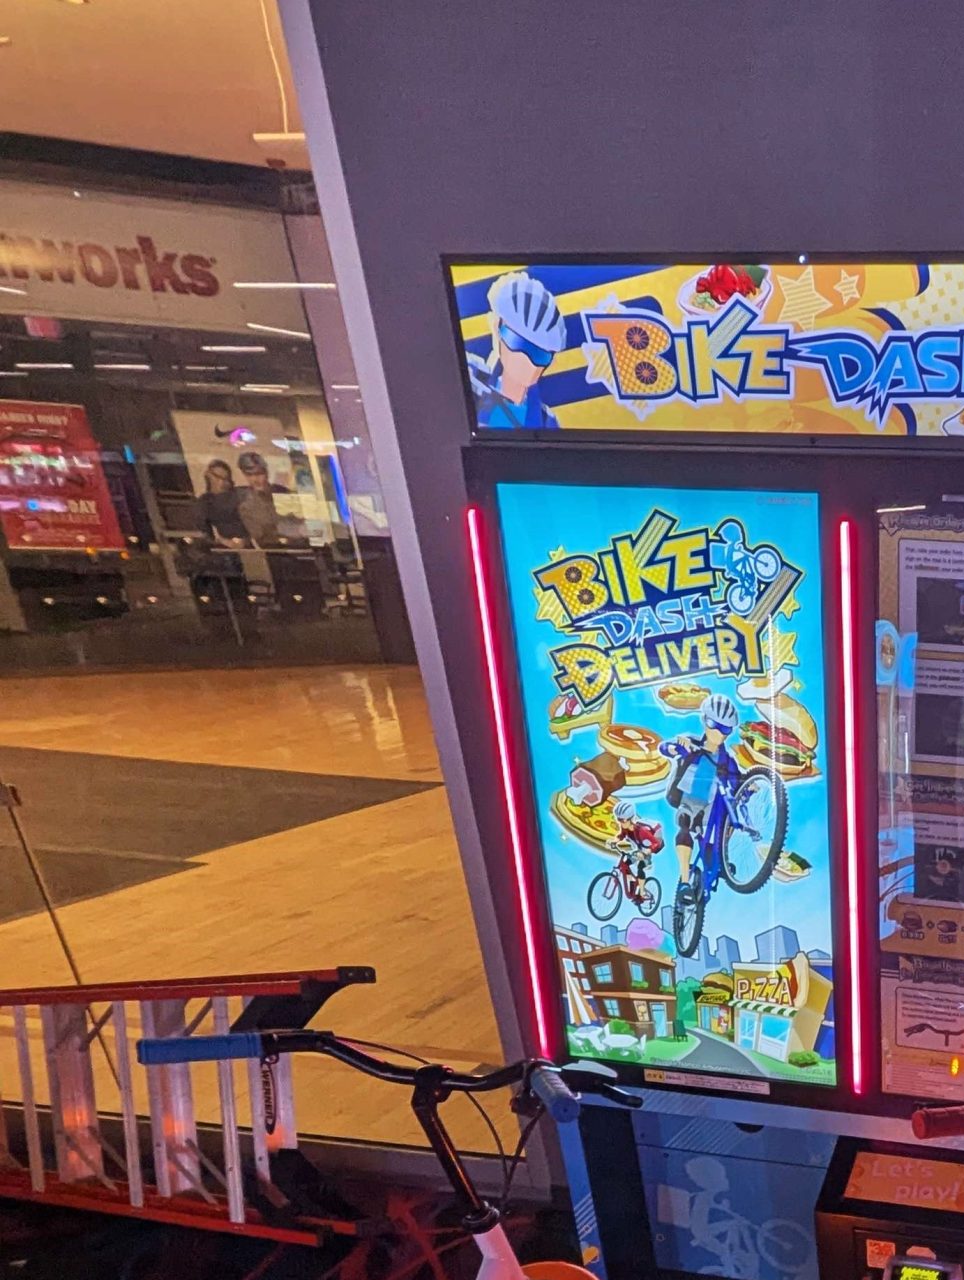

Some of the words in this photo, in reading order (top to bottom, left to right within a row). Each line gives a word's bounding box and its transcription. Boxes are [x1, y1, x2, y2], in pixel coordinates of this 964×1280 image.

[585, 299, 791, 400] BIKE
[533, 509, 715, 621] BIKE
[550, 560, 802, 707] DELIVERY
[578, 593, 728, 647] DASH
[872, 1160, 934, 1178] Let's
[895, 1182, 959, 1202] play!
